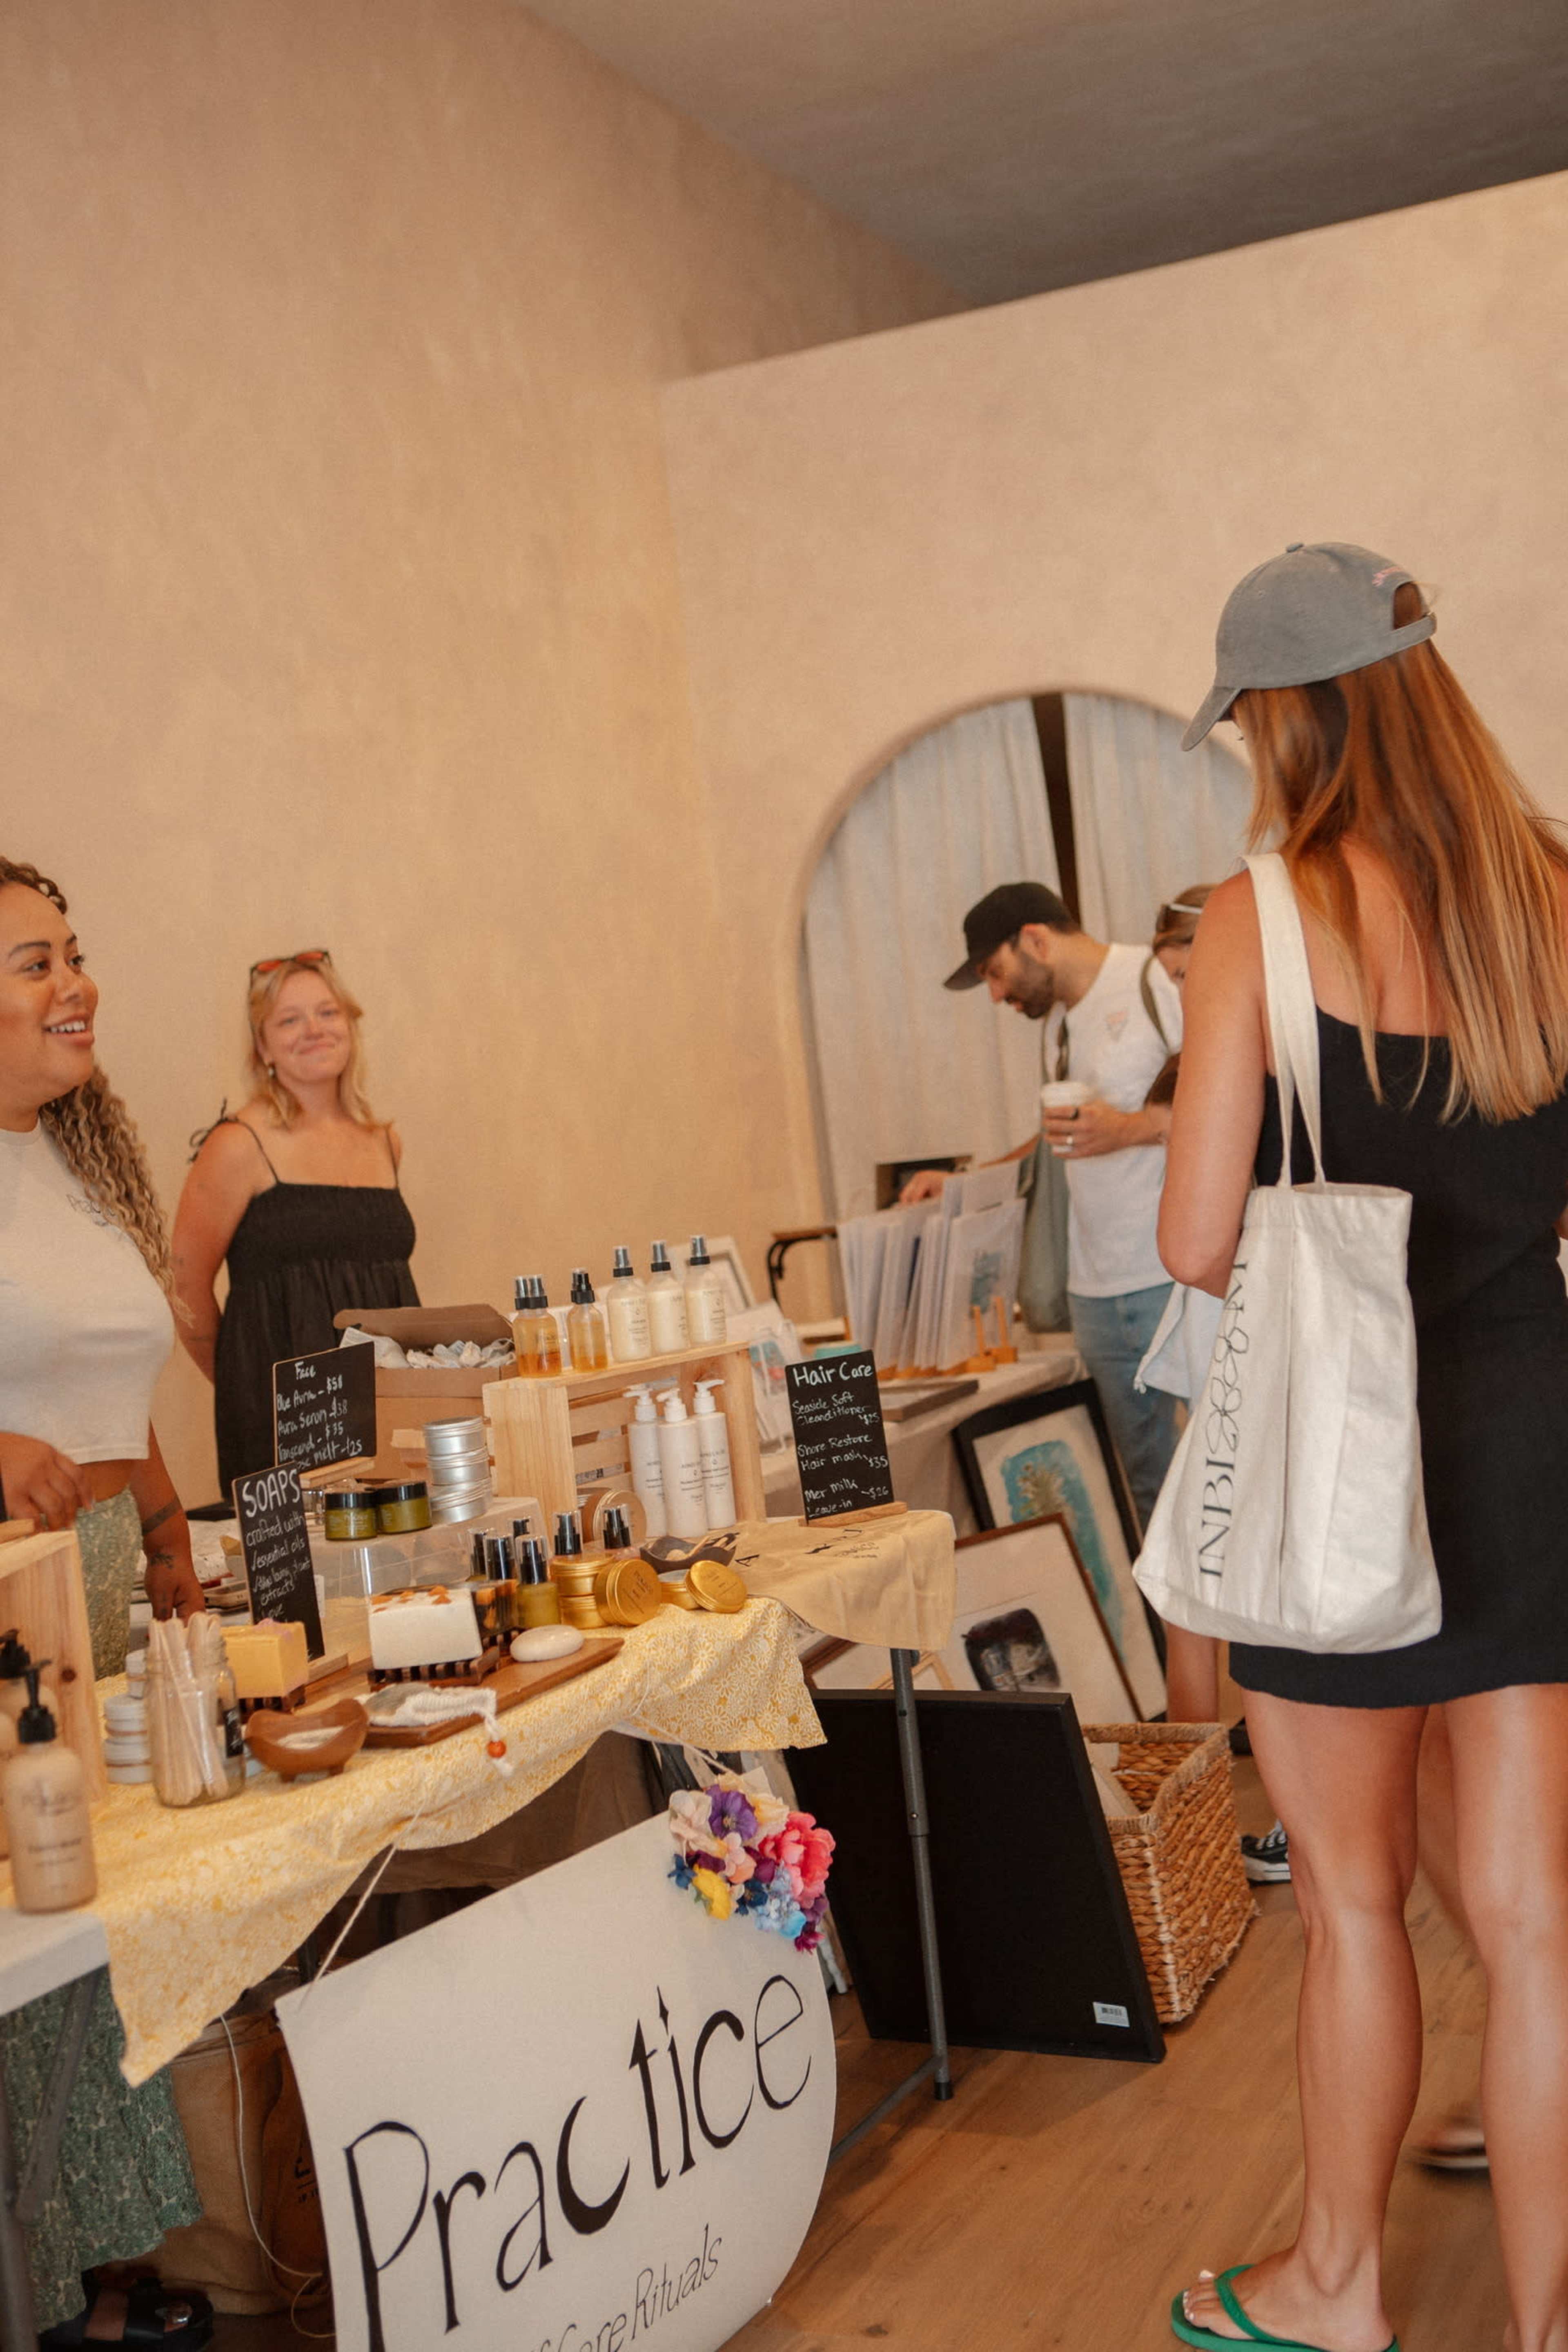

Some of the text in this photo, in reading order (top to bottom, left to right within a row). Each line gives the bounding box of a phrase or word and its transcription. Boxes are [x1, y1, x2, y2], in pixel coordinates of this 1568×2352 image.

[294, 1361, 316, 1381] Face
[793, 1362, 873, 1387] Hair Care
[792, 1391, 855, 1414] Seaside Soft
[797, 1434, 872, 1457] Shore Restore
[800, 1458, 826, 1471] Hair
[242, 1468, 301, 1518] SOAPS
[804, 1489, 827, 1503] Mer
[246, 1515, 283, 1547] crafted
[283, 1511, 304, 1532] with
[291, 1534, 305, 1553] oils
[342, 1975, 812, 2352] Practice
[557, 2222, 722, 2352] Cre Rituals
